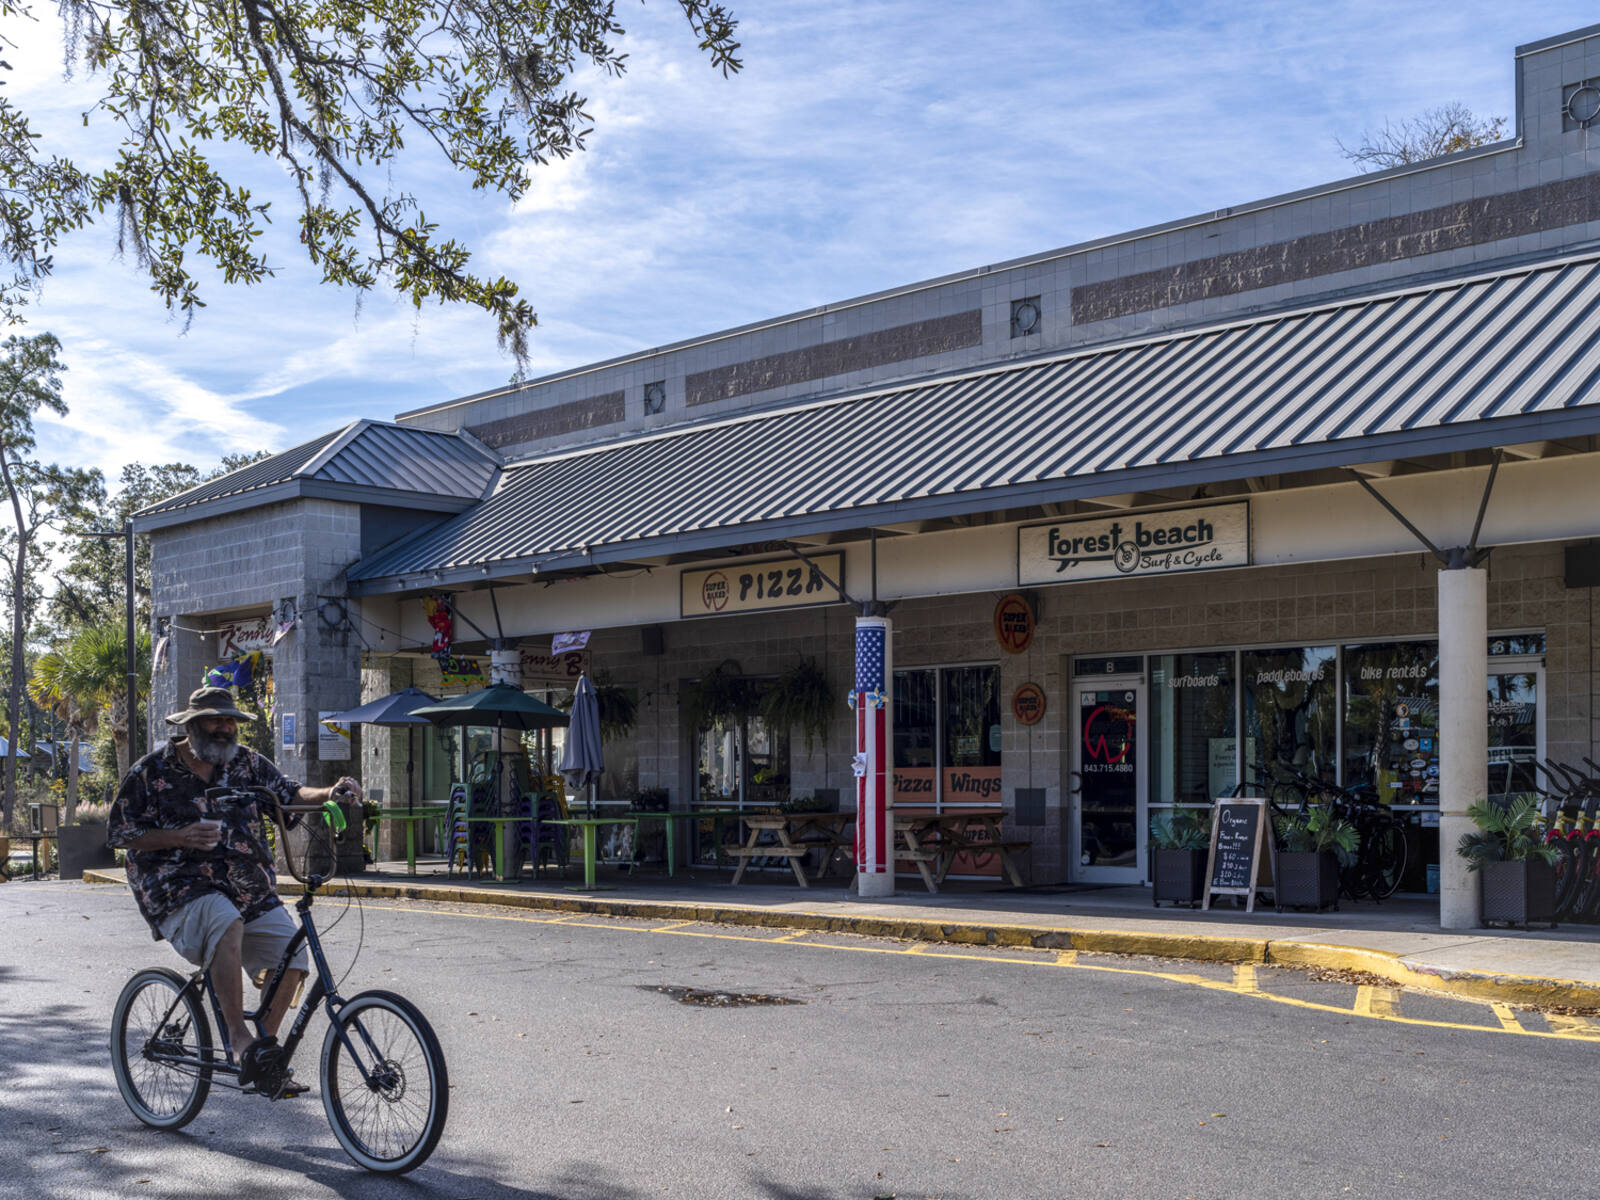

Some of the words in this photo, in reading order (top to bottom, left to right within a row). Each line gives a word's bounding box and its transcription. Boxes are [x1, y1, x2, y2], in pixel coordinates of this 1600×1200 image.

[1050, 523, 1122, 556] forest
[1136, 520, 1213, 547] beach
[1141, 553, 1173, 569] Surf
[1174, 557, 1182, 565] &
[1183, 548, 1222, 567] Cycle
[706, 581, 726, 592] SUPER
[739, 564, 823, 601] PIZZA
[221, 625, 273, 656] Kenny
[520, 651, 560, 670] enny
[1106, 662, 1114, 672] B
[1168, 673, 1219, 688] surfboards
[1256, 667, 1325, 685] paddleboards
[1360, 666, 1383, 680] bike
[1386, 664, 1428, 679] rentals
[951, 773, 1001, 797] Wings
[961, 830, 990, 841] UPER
